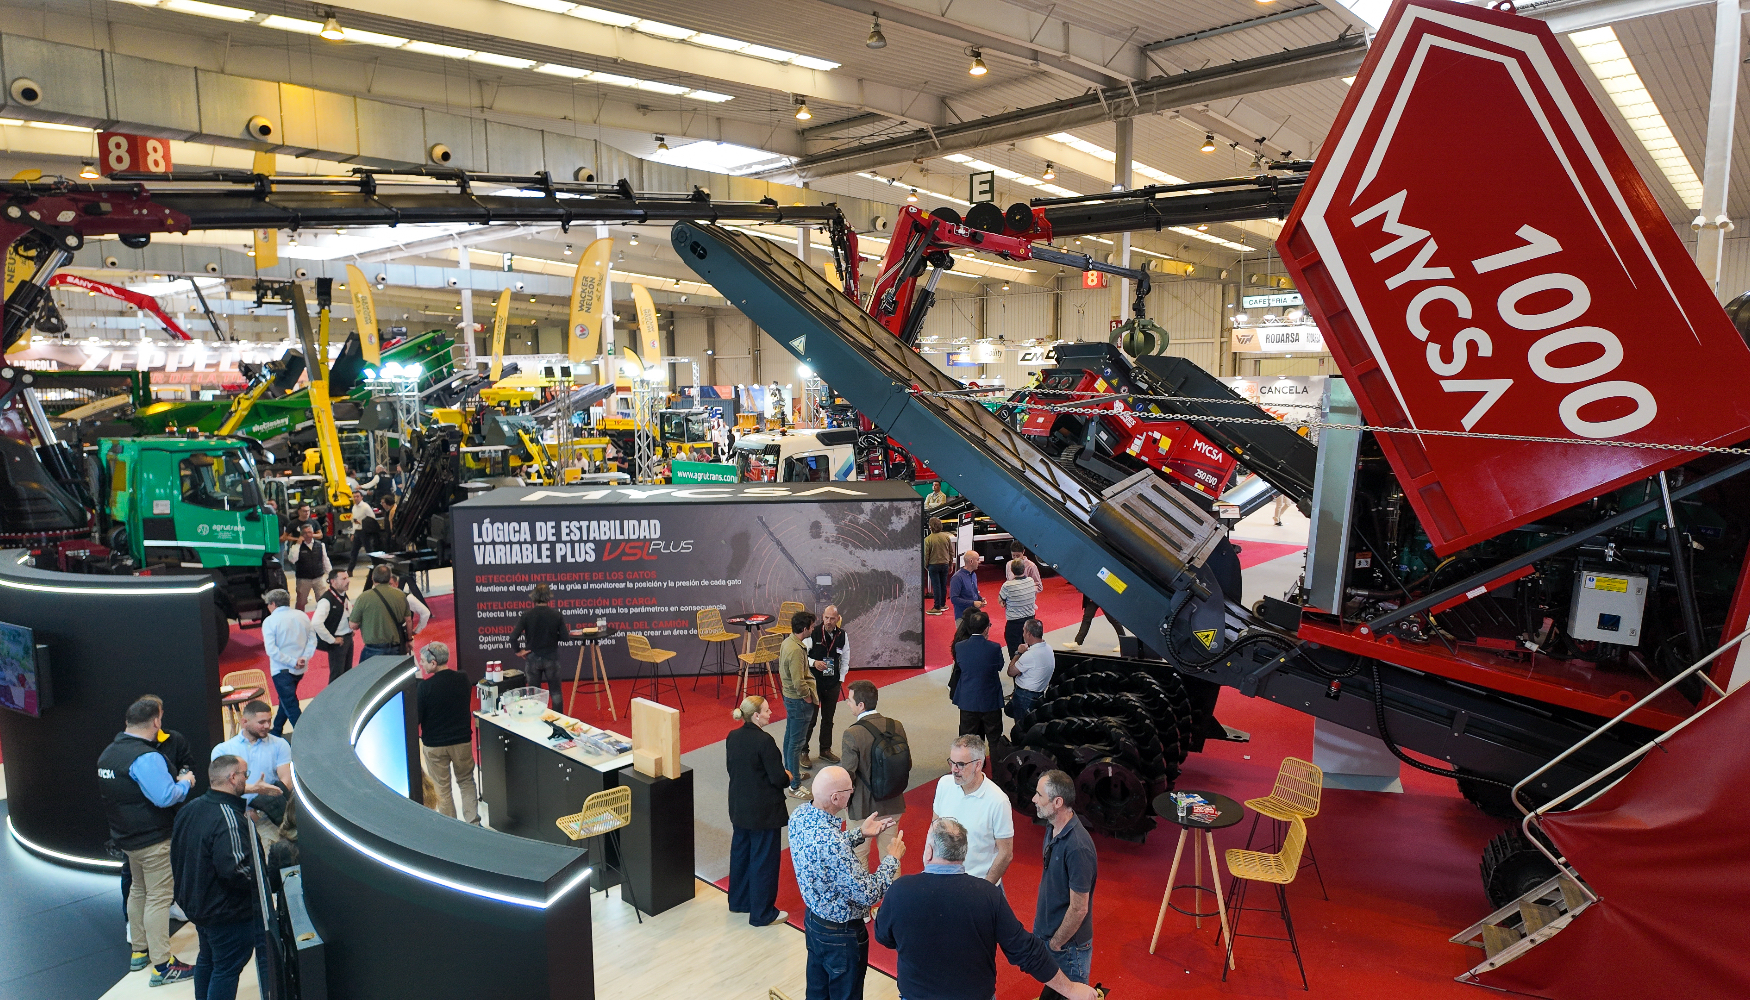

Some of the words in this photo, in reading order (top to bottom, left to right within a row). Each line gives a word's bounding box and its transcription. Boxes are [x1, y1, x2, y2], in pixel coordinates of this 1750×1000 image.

[108, 136, 130, 171] 8
[146, 139, 165, 173] 8
[973, 173, 991, 202] E
[503, 252, 512, 272] F
[1087, 270, 1098, 286] 8
[578, 275, 590, 312] WACKER
[585, 276, 596, 313] NEUSON
[1351, 189, 1514, 432] MYCSA
[1265, 333, 1300, 344] RODARSA
[1471, 224, 1658, 438] 1000
[1260, 386, 1309, 395] CANCELA
[1193, 438, 1223, 463] MYCSA
[1194, 468, 1207, 481] 250
[1206, 473, 1218, 486] EVO
[520, 486, 869, 501] MYCSA
[472, 518, 531, 543] LÓGICA
[536, 521, 557, 542] DE
[561, 519, 661, 541] ESTABILIDAD
[473, 543, 551, 565] VARIABLE
[555, 542, 596, 563] PLUS
[649, 540, 694, 553] PLUS
[475, 572, 529, 583] DETECCIÓN
[530, 572, 592, 582] INTELIGENTE
[593, 571, 605, 581] DE
[606, 571, 624, 580] LOS
[626, 570, 657, 580] GATOS
[476, 584, 508, 592] Mantiene
[566, 582, 582, 592] grúa
[589, 580, 626, 590] monitorear
[634, 580, 662, 590] posición
[675, 579, 700, 588] presión
[710, 578, 726, 586] cada
[726, 579, 742, 587] gato
[477, 610, 505, 618] Detecta
[505, 609, 517, 618] las
[562, 607, 588, 616] camión
[594, 608, 617, 616] ajusta
[617, 606, 629, 614] los
[629, 605, 669, 615] parámetros
[670, 605, 679, 613] en
[557, 597, 610, 608] DETECCIÓN
[611, 598, 624, 606] DE
[625, 597, 658, 606] CARGA
[633, 620, 650, 630] DEL
[651, 618, 689, 630] CAMIÓN
[643, 629, 662, 637] crear
[662, 629, 672, 637] un
[672, 627, 688, 636] área
[688, 627, 698, 636] de
